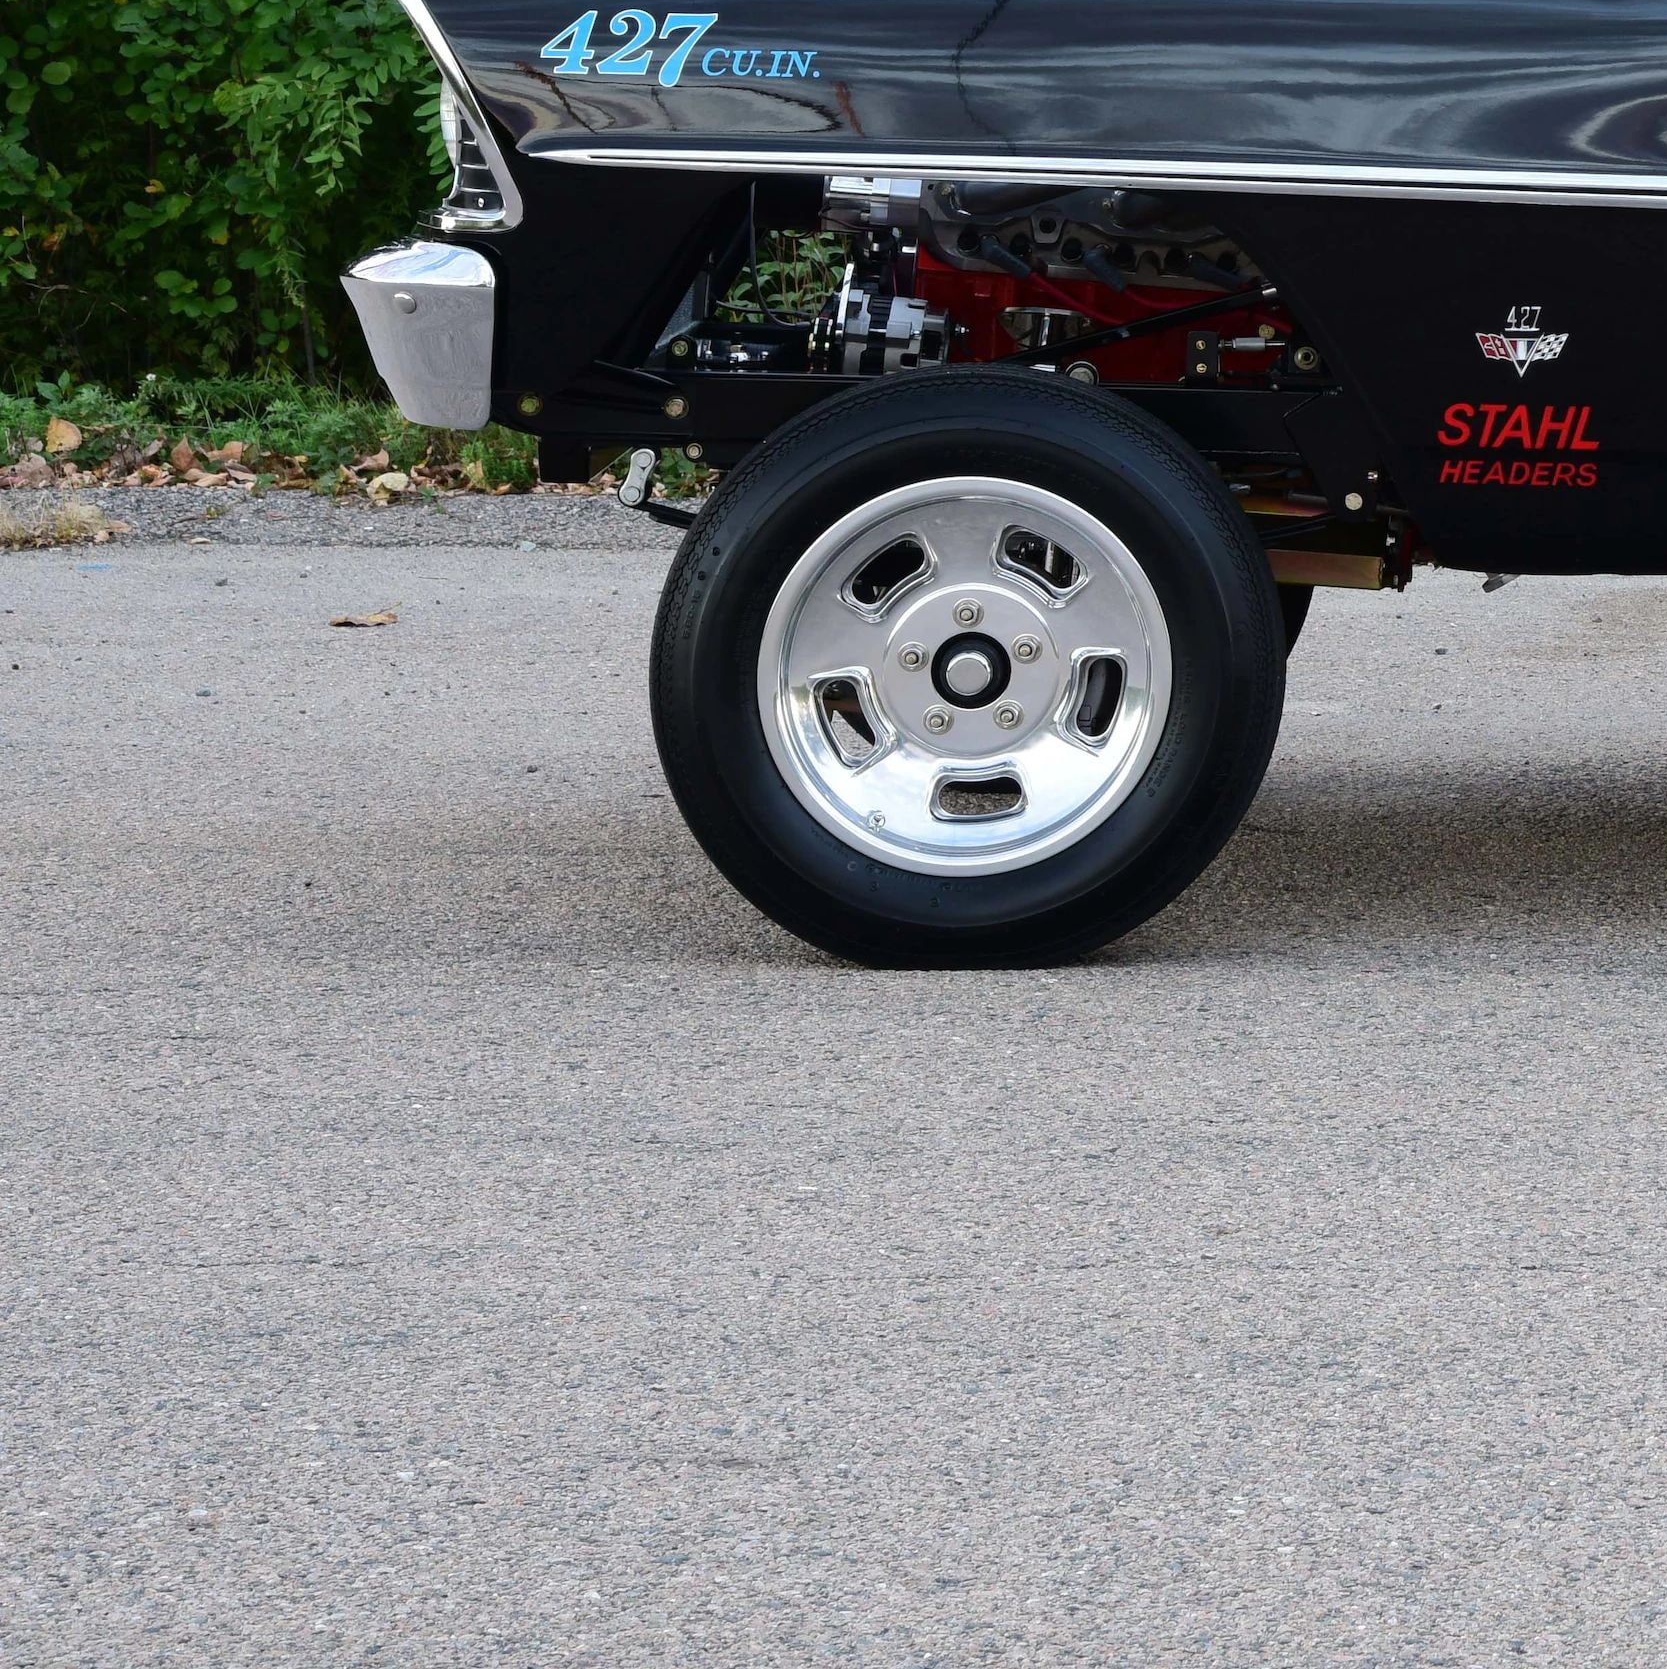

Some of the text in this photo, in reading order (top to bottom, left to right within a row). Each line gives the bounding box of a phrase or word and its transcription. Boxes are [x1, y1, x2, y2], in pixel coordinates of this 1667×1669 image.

[540, 9, 821, 87] 427 CU.IN.
[1505, 305, 1542, 330] 427
[1437, 403, 1599, 450] STAHL
[1440, 460, 1598, 487] HEADERS
